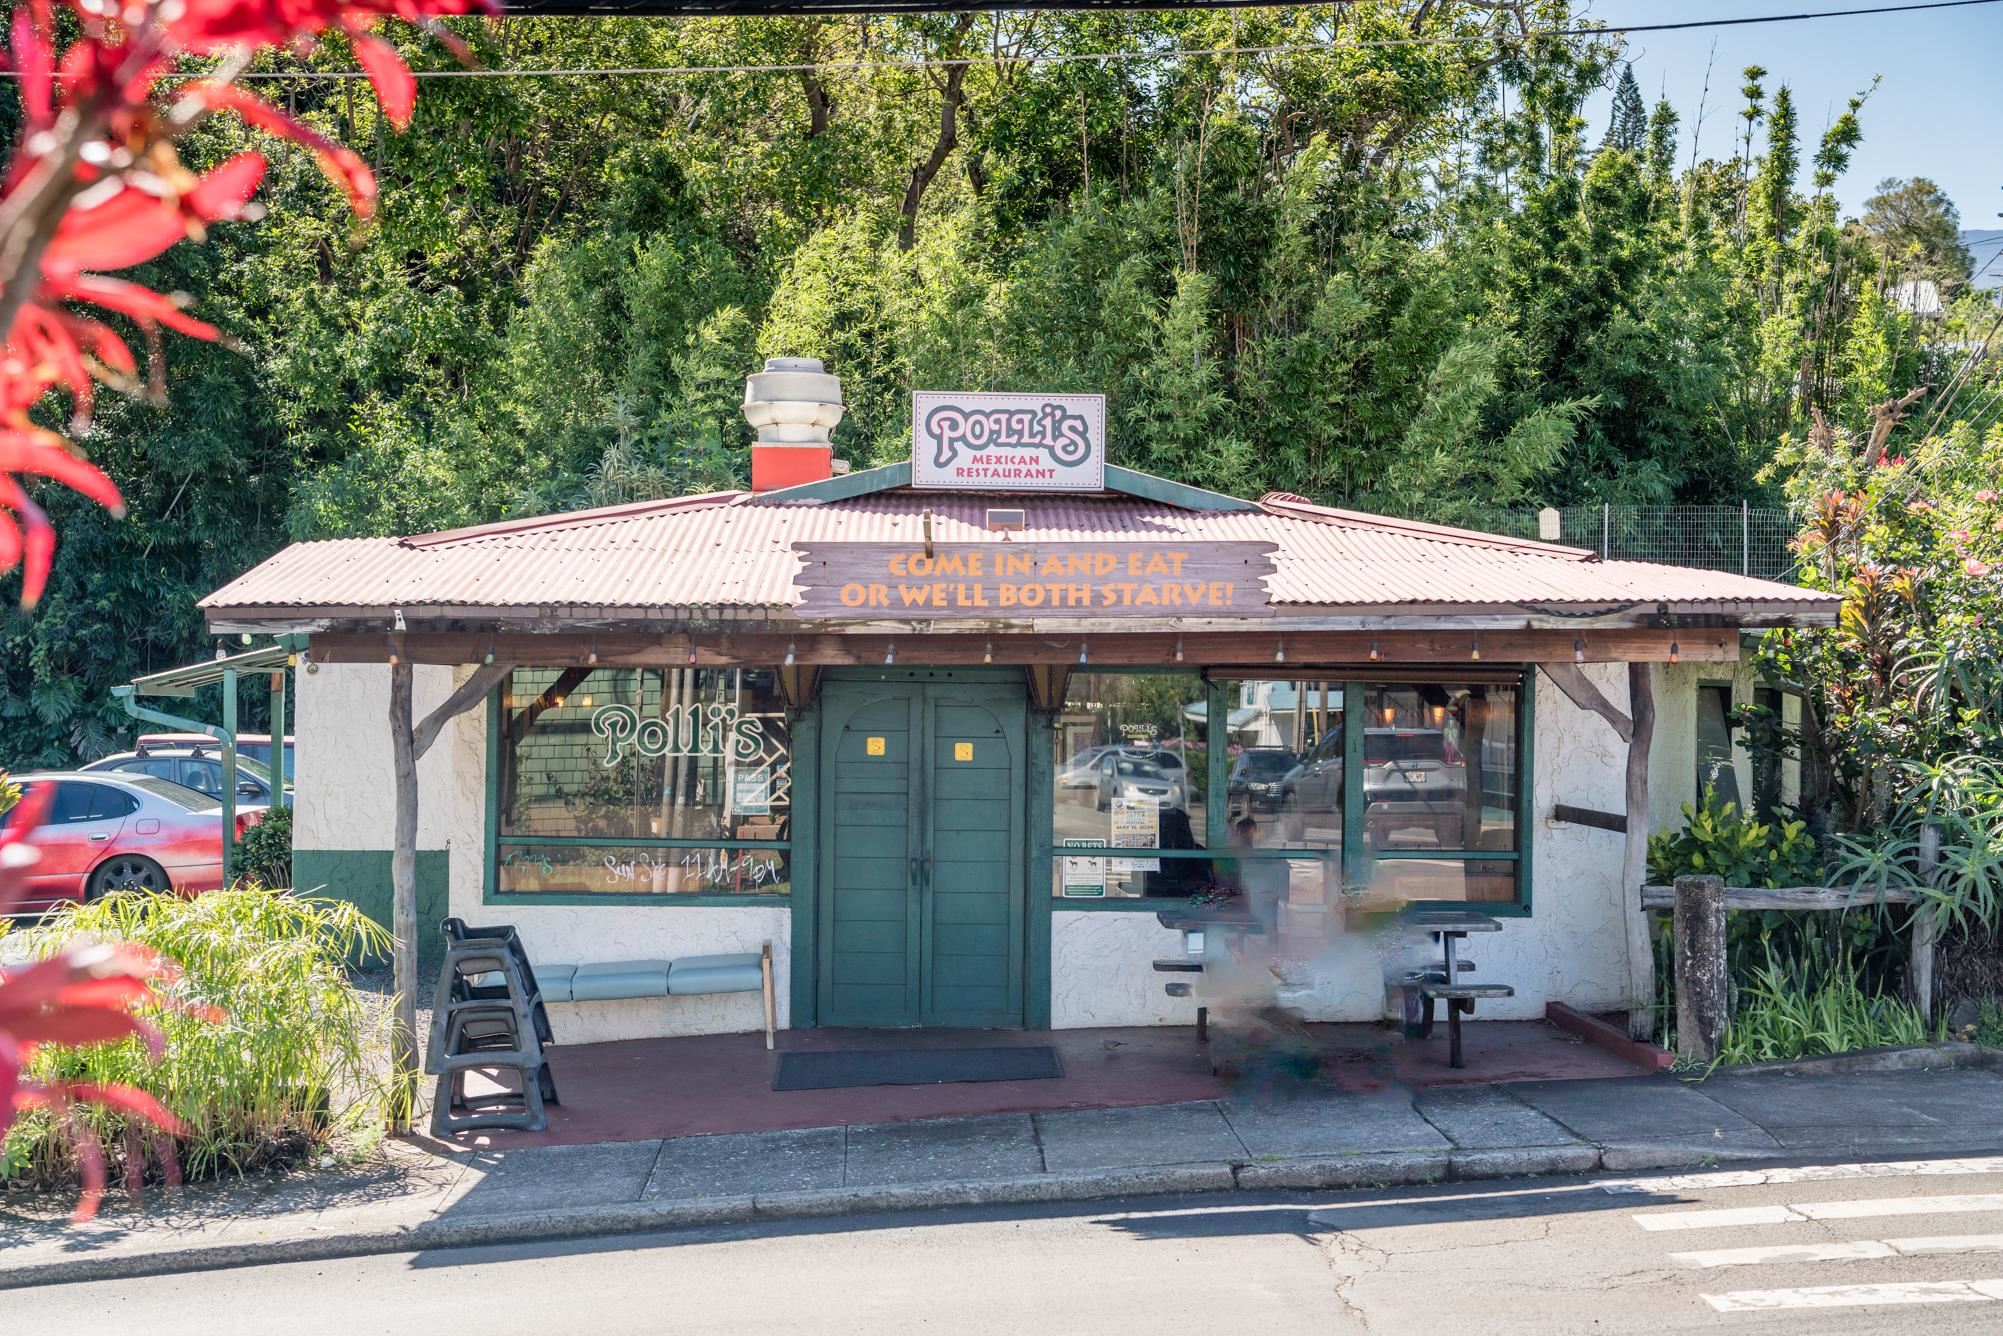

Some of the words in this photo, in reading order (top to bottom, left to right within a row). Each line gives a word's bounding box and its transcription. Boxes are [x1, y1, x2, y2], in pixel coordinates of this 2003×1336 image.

[971, 454, 1040, 466] MEXICAN
[956, 467, 1056, 479] RESTAURANT
[888, 552, 984, 577] COME
[994, 552, 1031, 576] IN
[1041, 552, 1118, 577] AND
[1128, 552, 1189, 577] EAT
[840, 583, 890, 608] OR
[898, 583, 989, 608] WE'LL
[999, 582, 1092, 608] BOTH
[1102, 582, 1233, 608] STARVE!
[592, 703, 764, 767] Polli's
[737, 774, 764, 782] PASS
